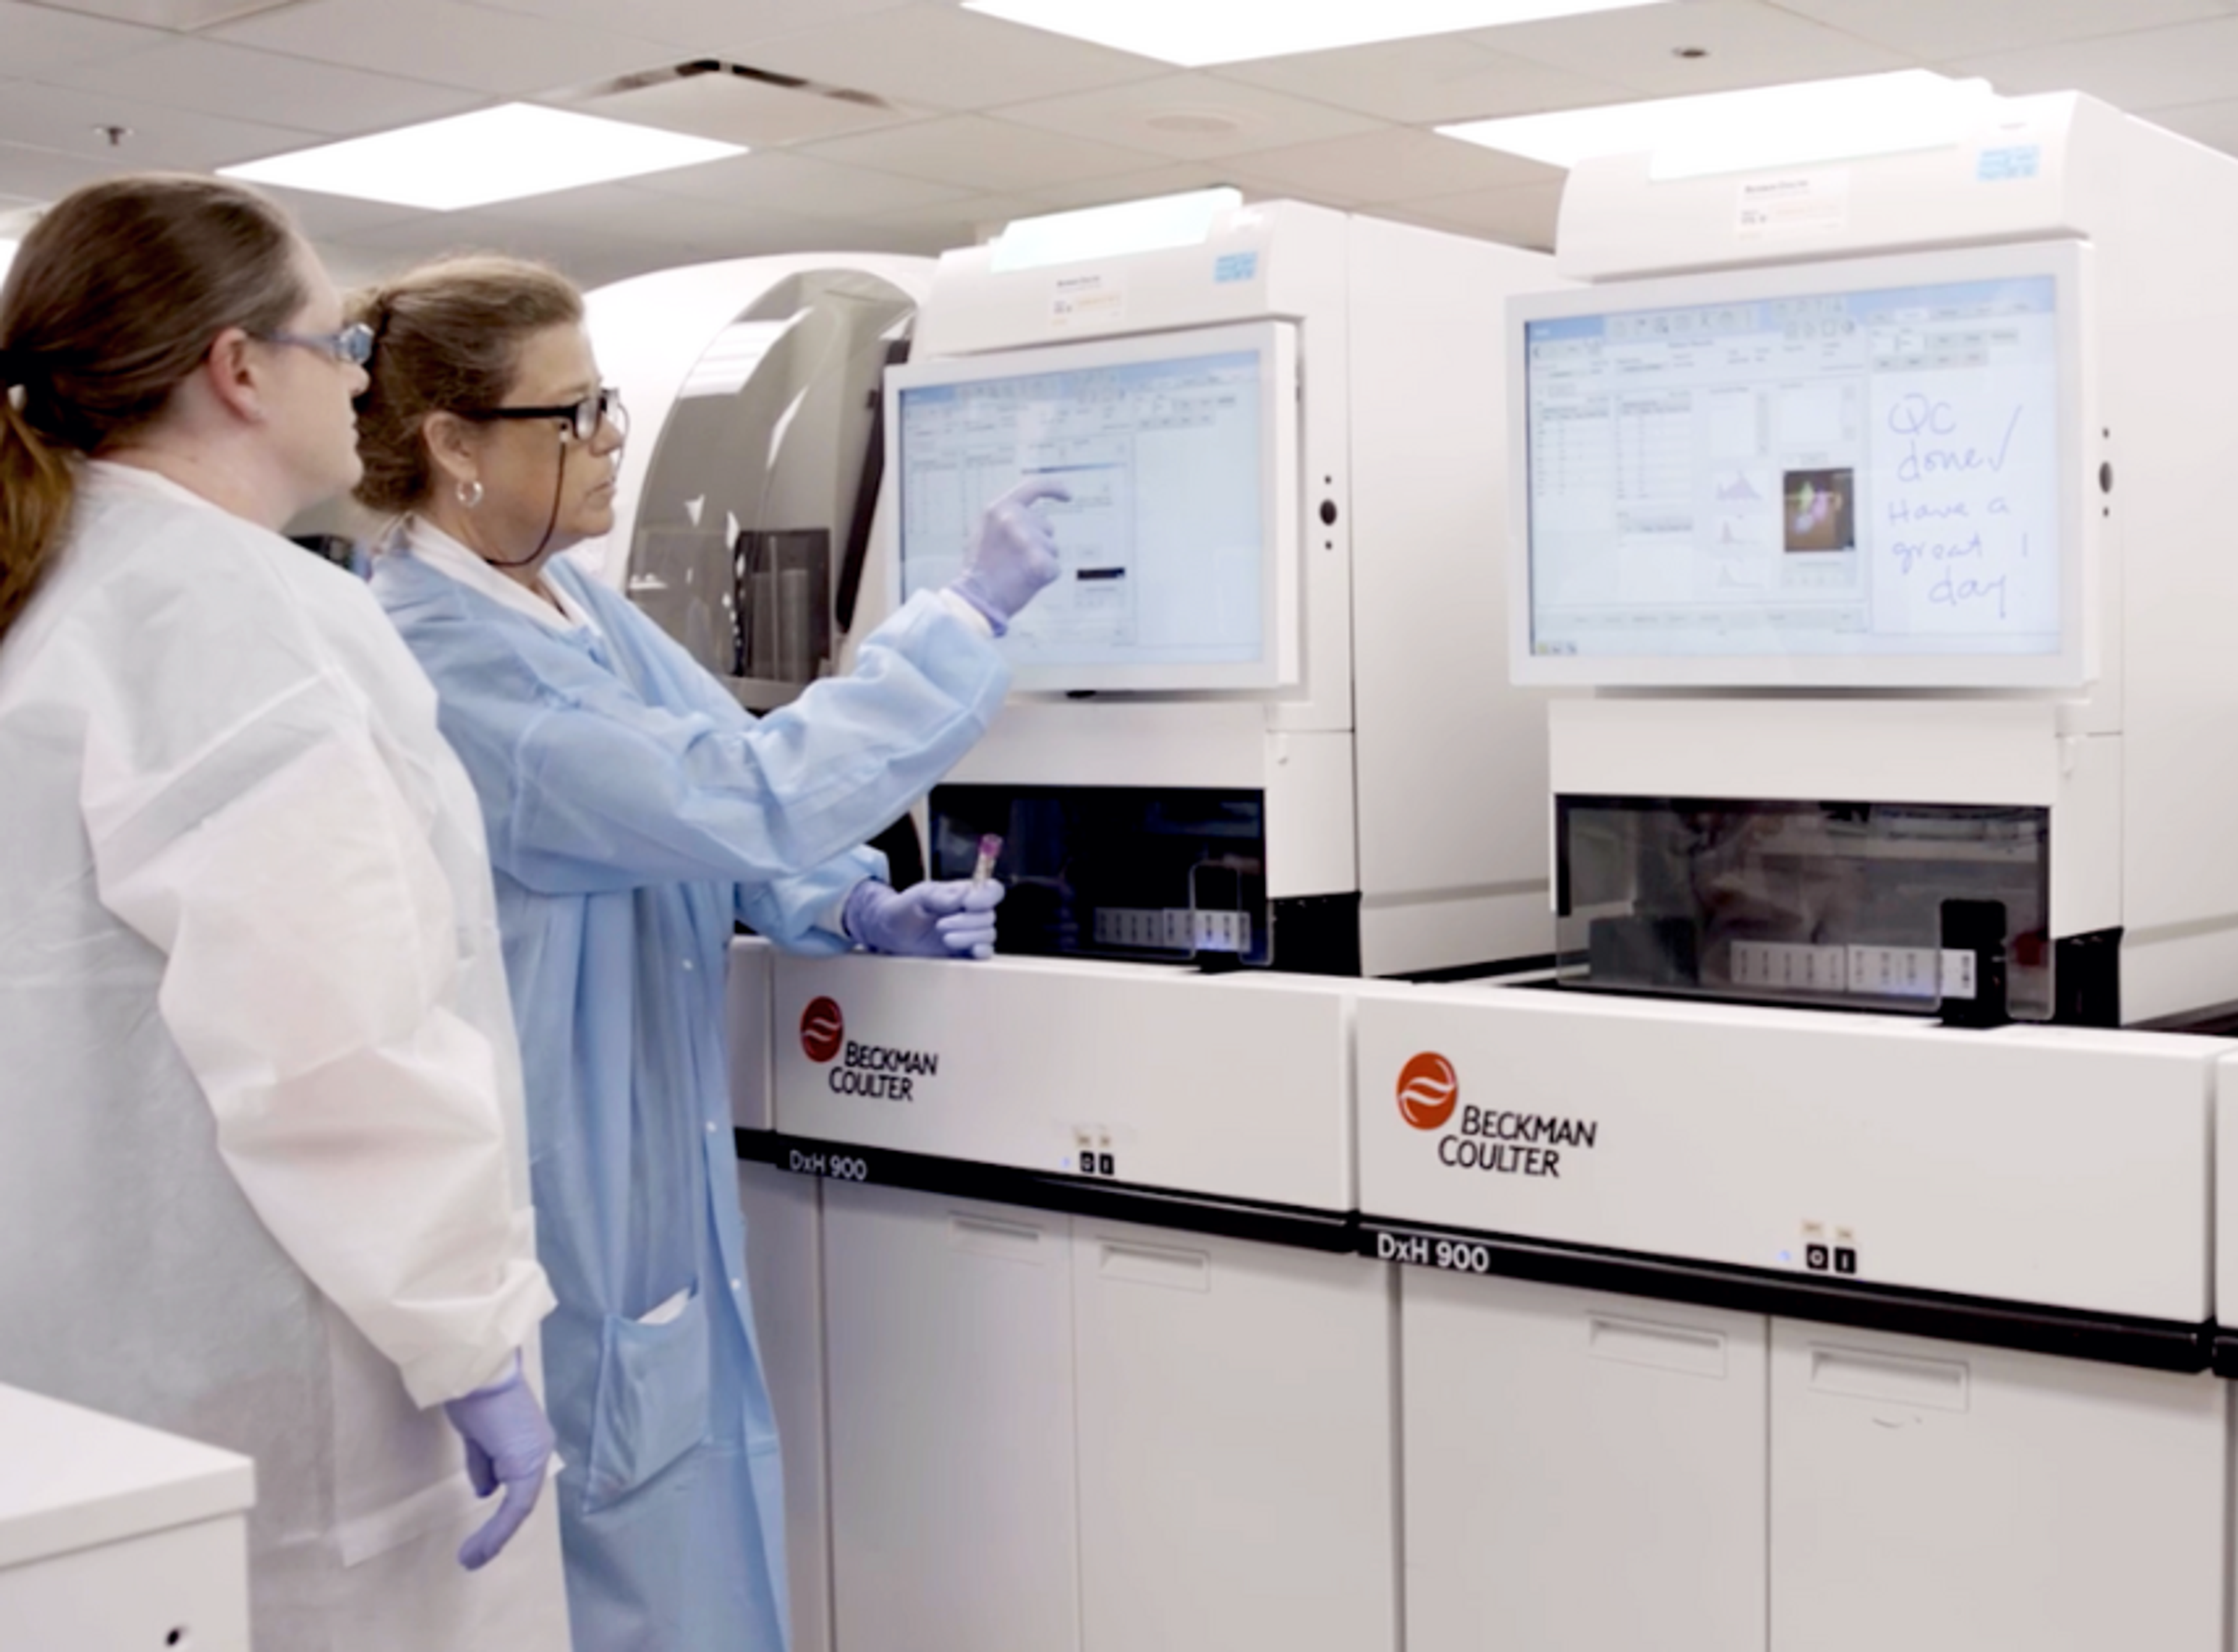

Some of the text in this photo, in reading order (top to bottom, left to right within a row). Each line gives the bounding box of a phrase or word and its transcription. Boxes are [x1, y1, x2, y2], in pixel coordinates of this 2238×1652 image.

[1888, 392, 1957, 435] QC
[1888, 496, 2010, 526] Have a
[1892, 531, 1982, 574] great
[1928, 564, 2006, 619] day
[844, 1041, 938, 1076] BECKMAN
[829, 1066, 914, 1101] COULTER
[1461, 1105, 1597, 1148] BECKMAN
[789, 1149, 868, 1181] DxH 900
[1438, 1134, 1560, 1178] COULTER
[1377, 1232, 1490, 1272] DxH 900
